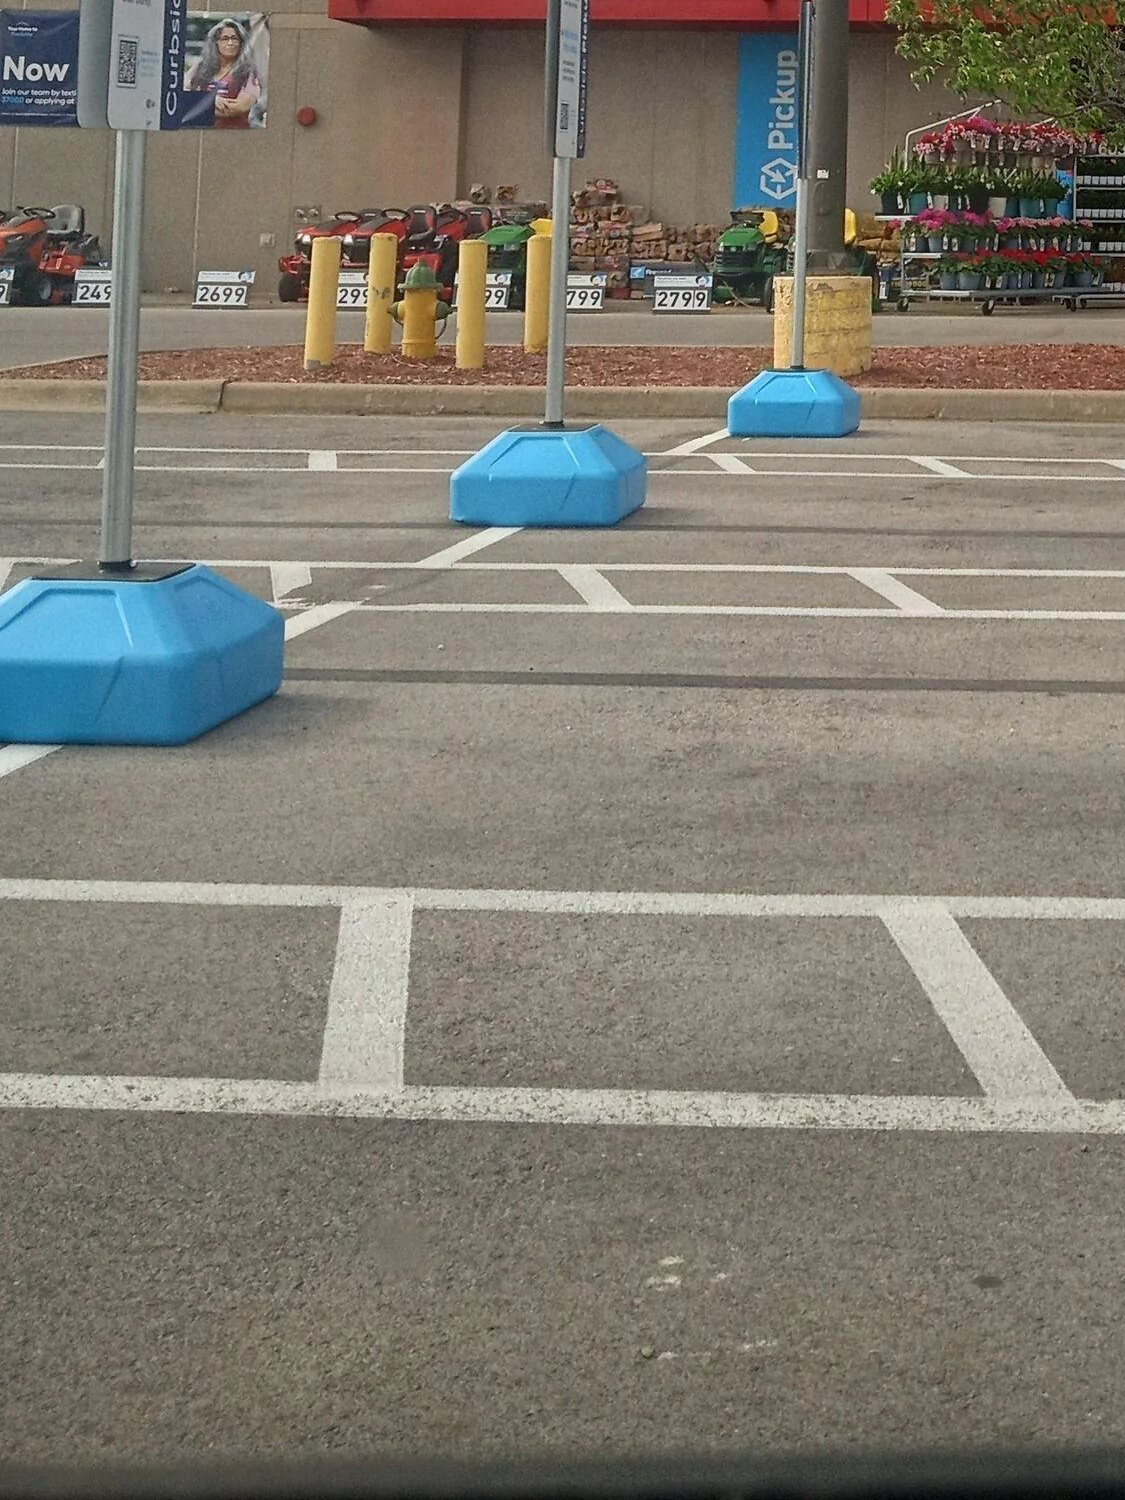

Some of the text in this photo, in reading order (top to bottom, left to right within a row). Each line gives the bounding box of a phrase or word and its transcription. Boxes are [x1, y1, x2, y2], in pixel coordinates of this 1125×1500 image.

[3, 55, 69, 81] Now
[51, 89, 60, 97] by
[767, 49, 799, 150] Pickup
[34, 97, 66, 106] applying
[79, 285, 112, 300] 249
[199, 286, 245, 303] 2699
[567, 290, 600, 306] 799
[657, 291, 706, 307] 2799
